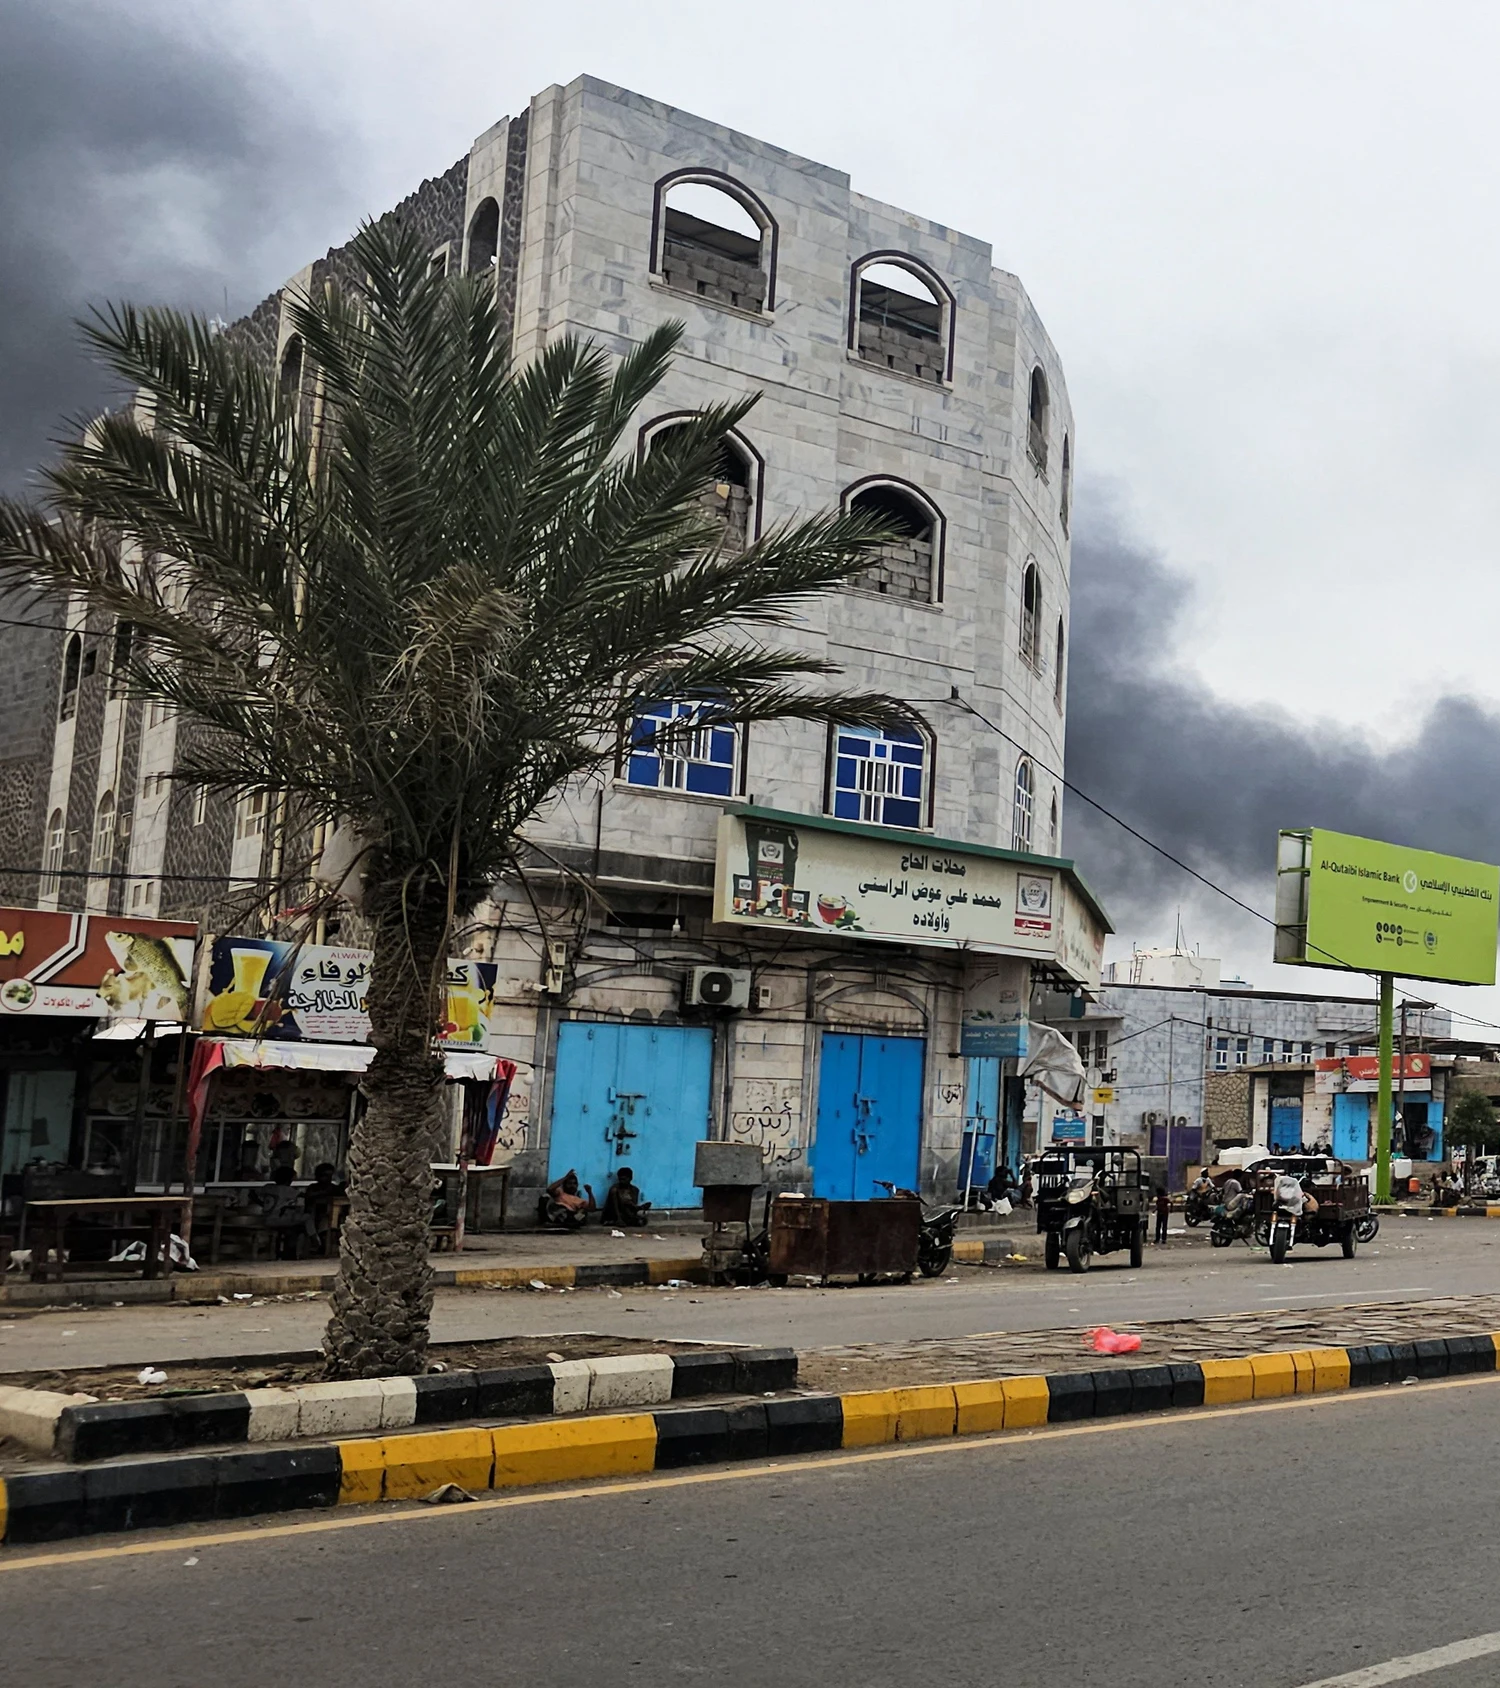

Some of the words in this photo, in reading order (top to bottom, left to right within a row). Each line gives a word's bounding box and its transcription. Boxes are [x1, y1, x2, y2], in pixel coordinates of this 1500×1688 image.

[900, 852, 928, 872] الحاج
[931, 858, 966, 877] محلات
[1320, 860, 1357, 875] Al-Qutaibi
[1358, 867, 1382, 881] Islamic
[1383, 871, 1400, 884] Bank
[911, 882, 942, 903] عوض
[945, 888, 968, 909] علي
[972, 893, 1002, 909] محمد
[1451, 885, 1480, 898] القطيبي
[1480, 890, 1492, 902] بنك
[288, 989, 359, 1013] الطازجة
